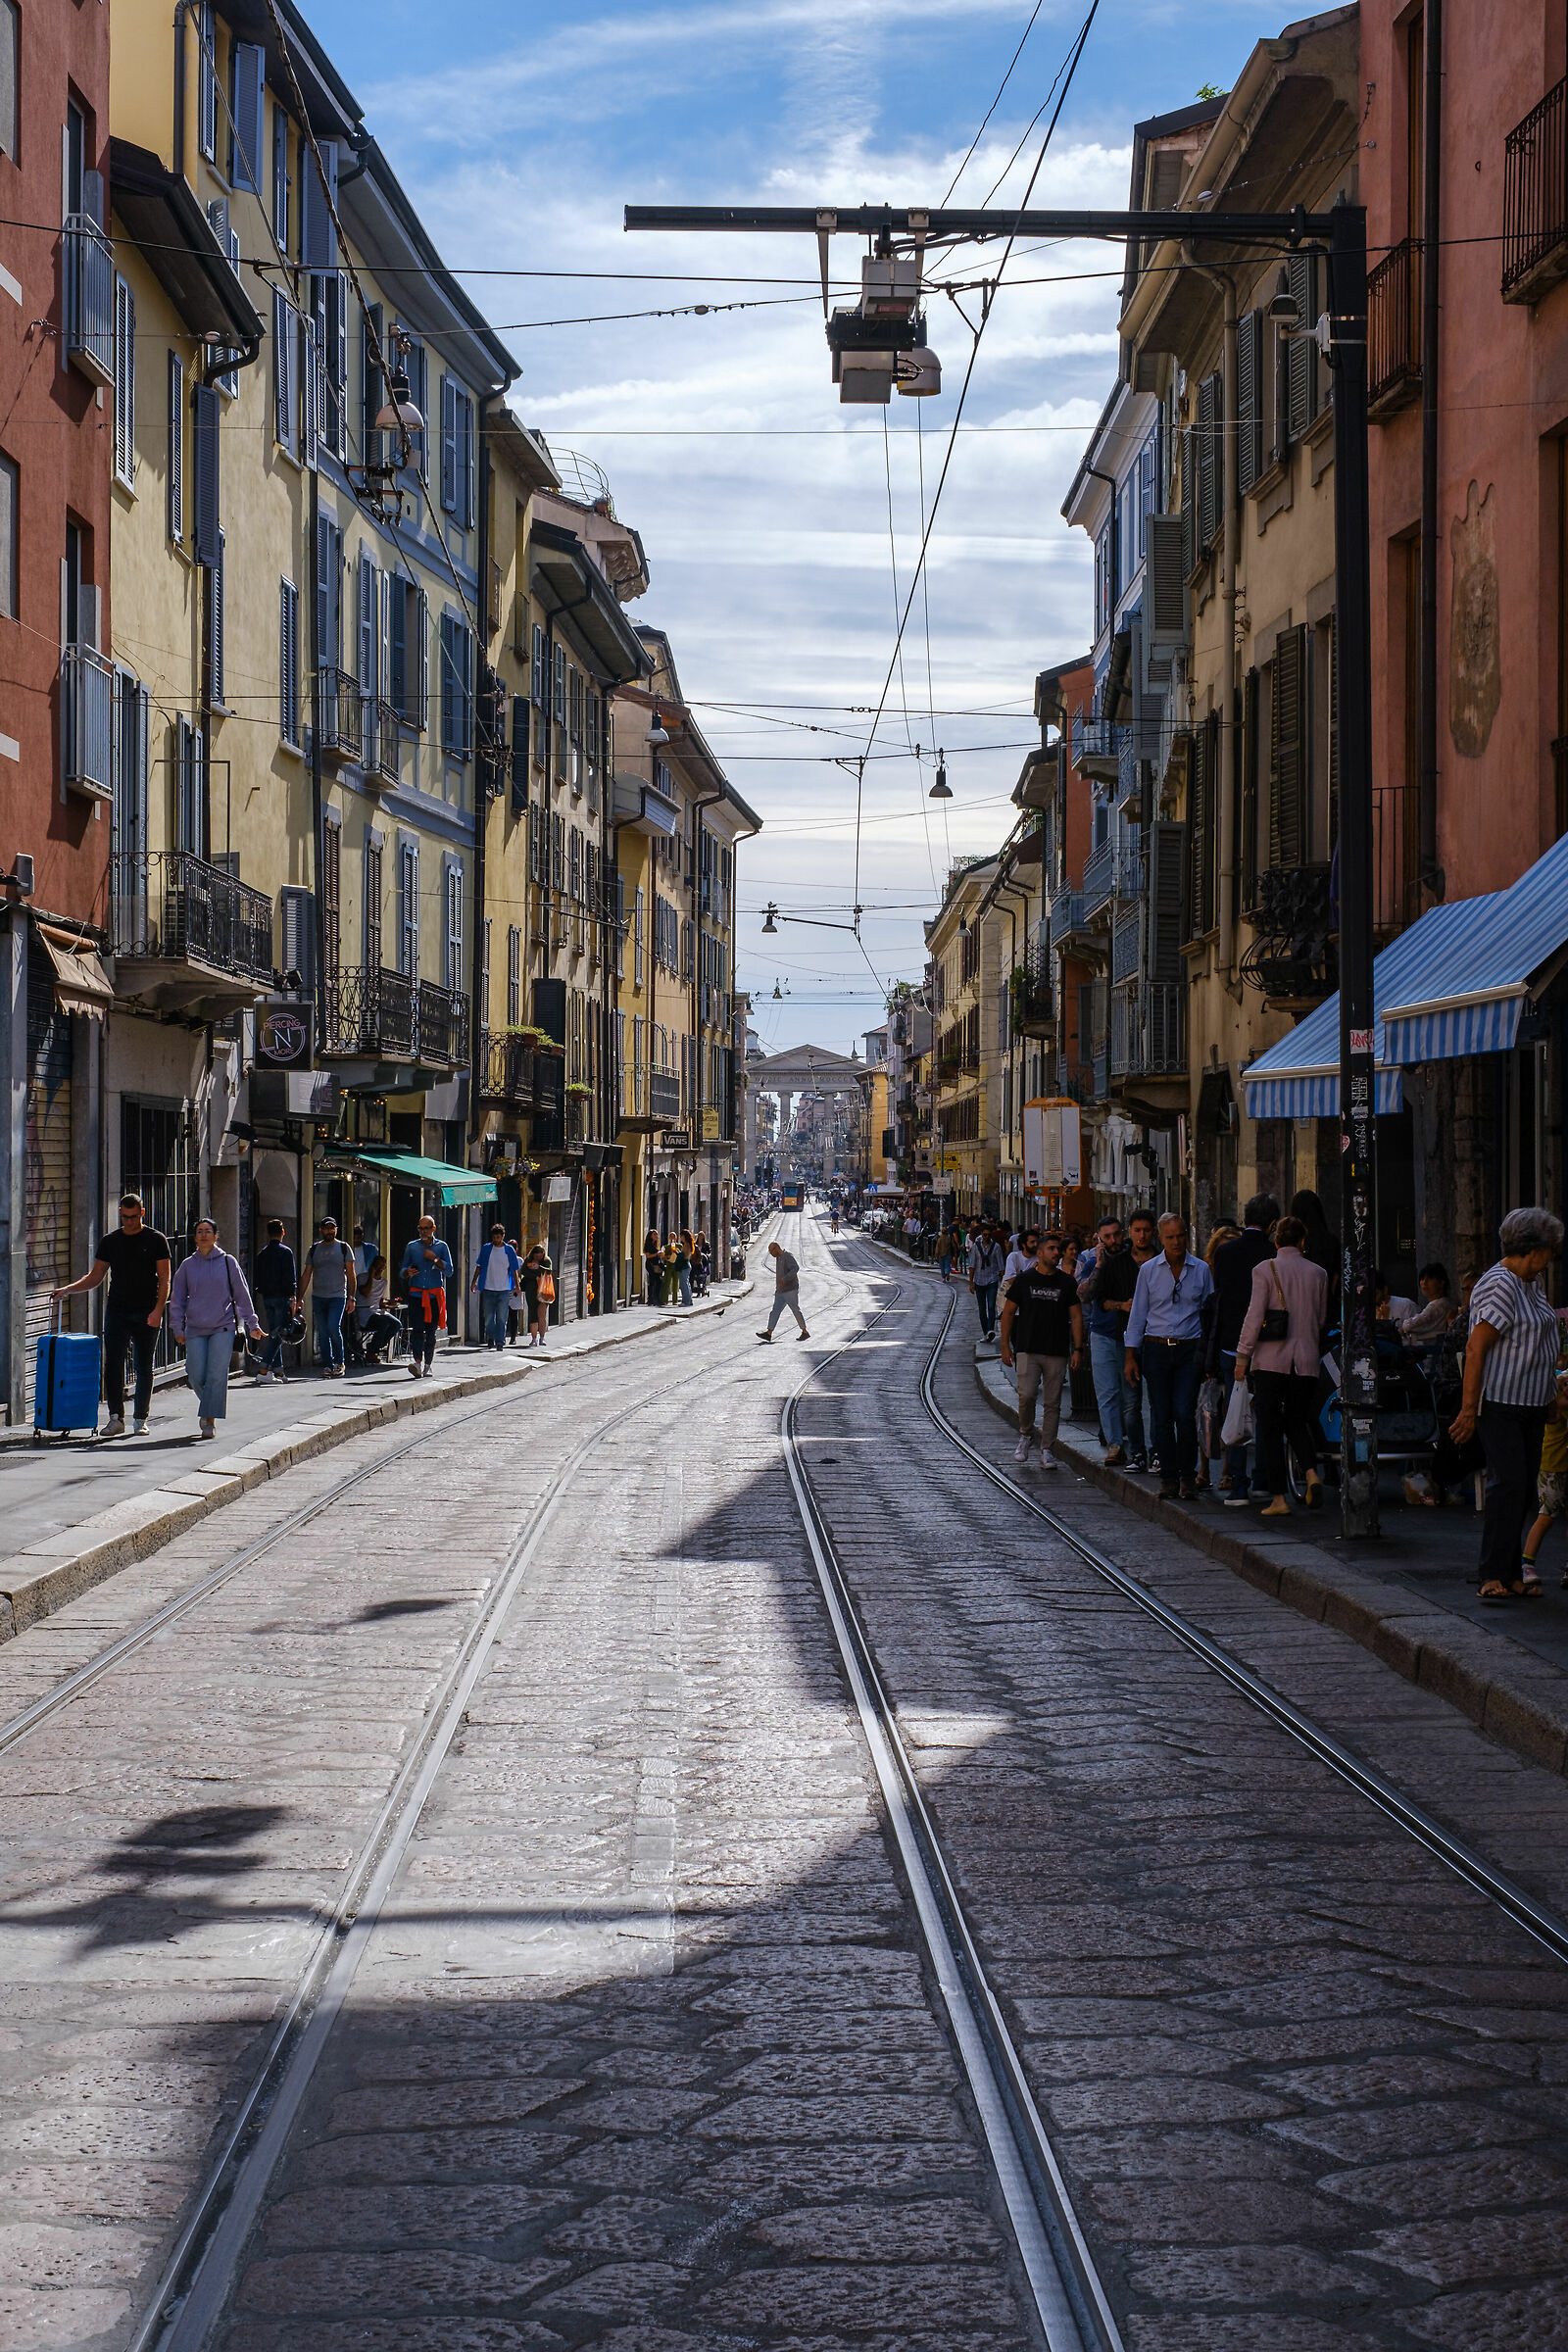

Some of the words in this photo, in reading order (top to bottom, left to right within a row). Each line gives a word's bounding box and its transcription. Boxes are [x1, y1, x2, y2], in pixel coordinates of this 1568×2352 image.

[264, 1019, 300, 1030] PIERCING
[274, 1028, 291, 1050] N
[664, 1136, 687, 1145] VANS
